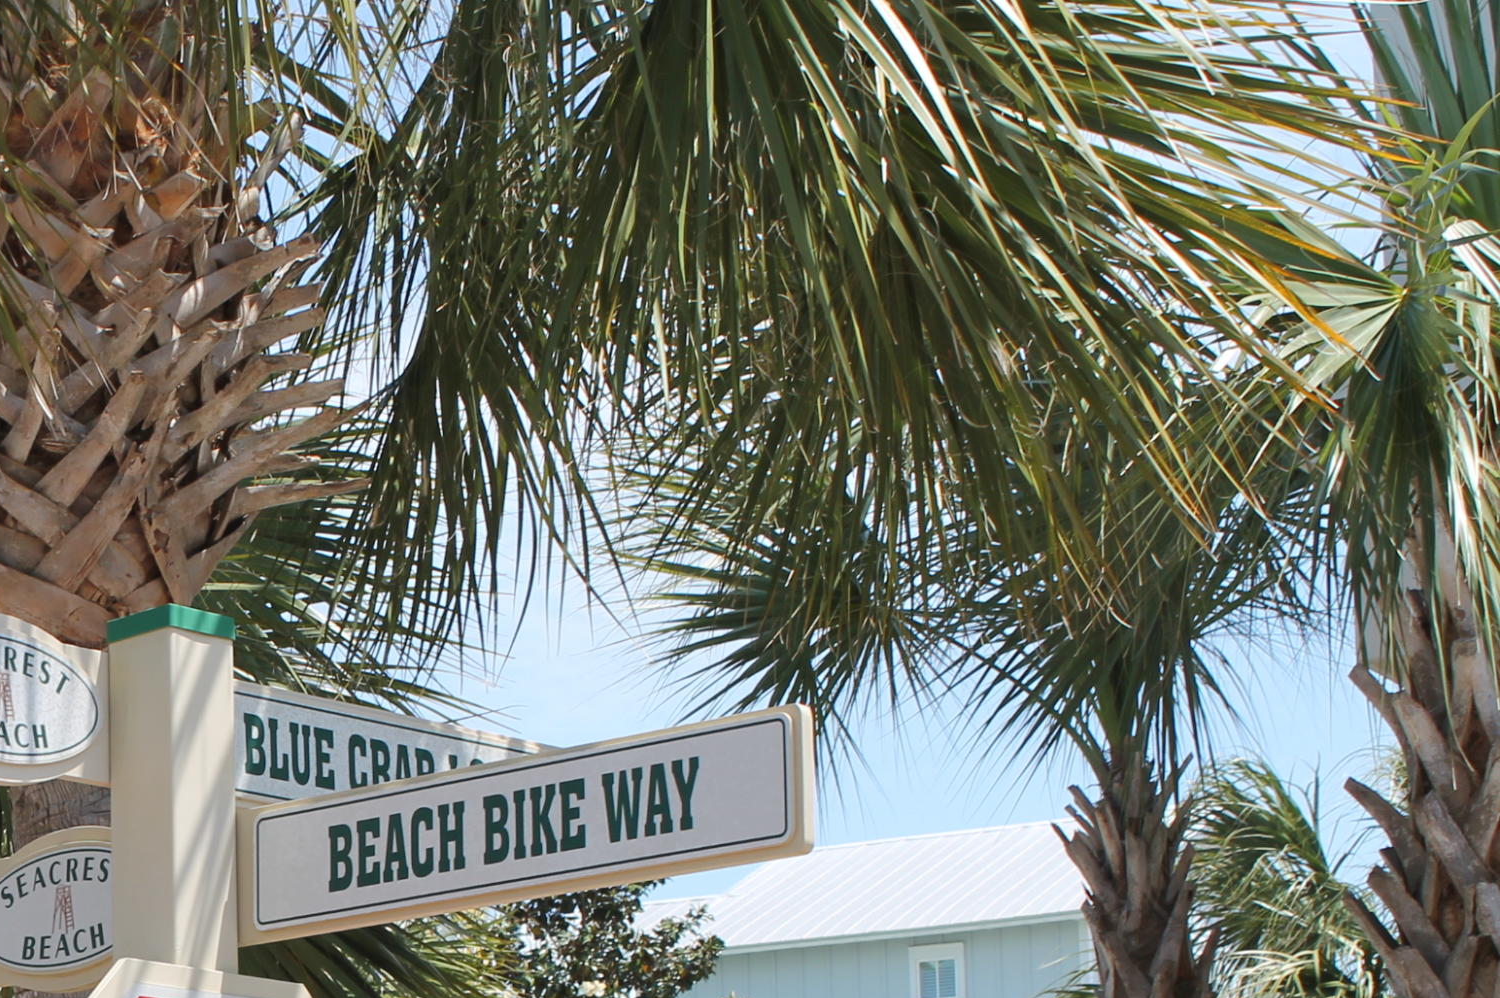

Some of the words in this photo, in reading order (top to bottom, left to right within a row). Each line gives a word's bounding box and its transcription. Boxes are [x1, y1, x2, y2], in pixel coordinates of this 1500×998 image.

[243, 712, 335, 790] BLUE
[328, 800, 466, 893] BEACH
[482, 778, 587, 865] BIKE
[601, 756, 700, 843] WAY
[1, 857, 110, 909] SEACRES
[21, 922, 106, 961] BEACH
